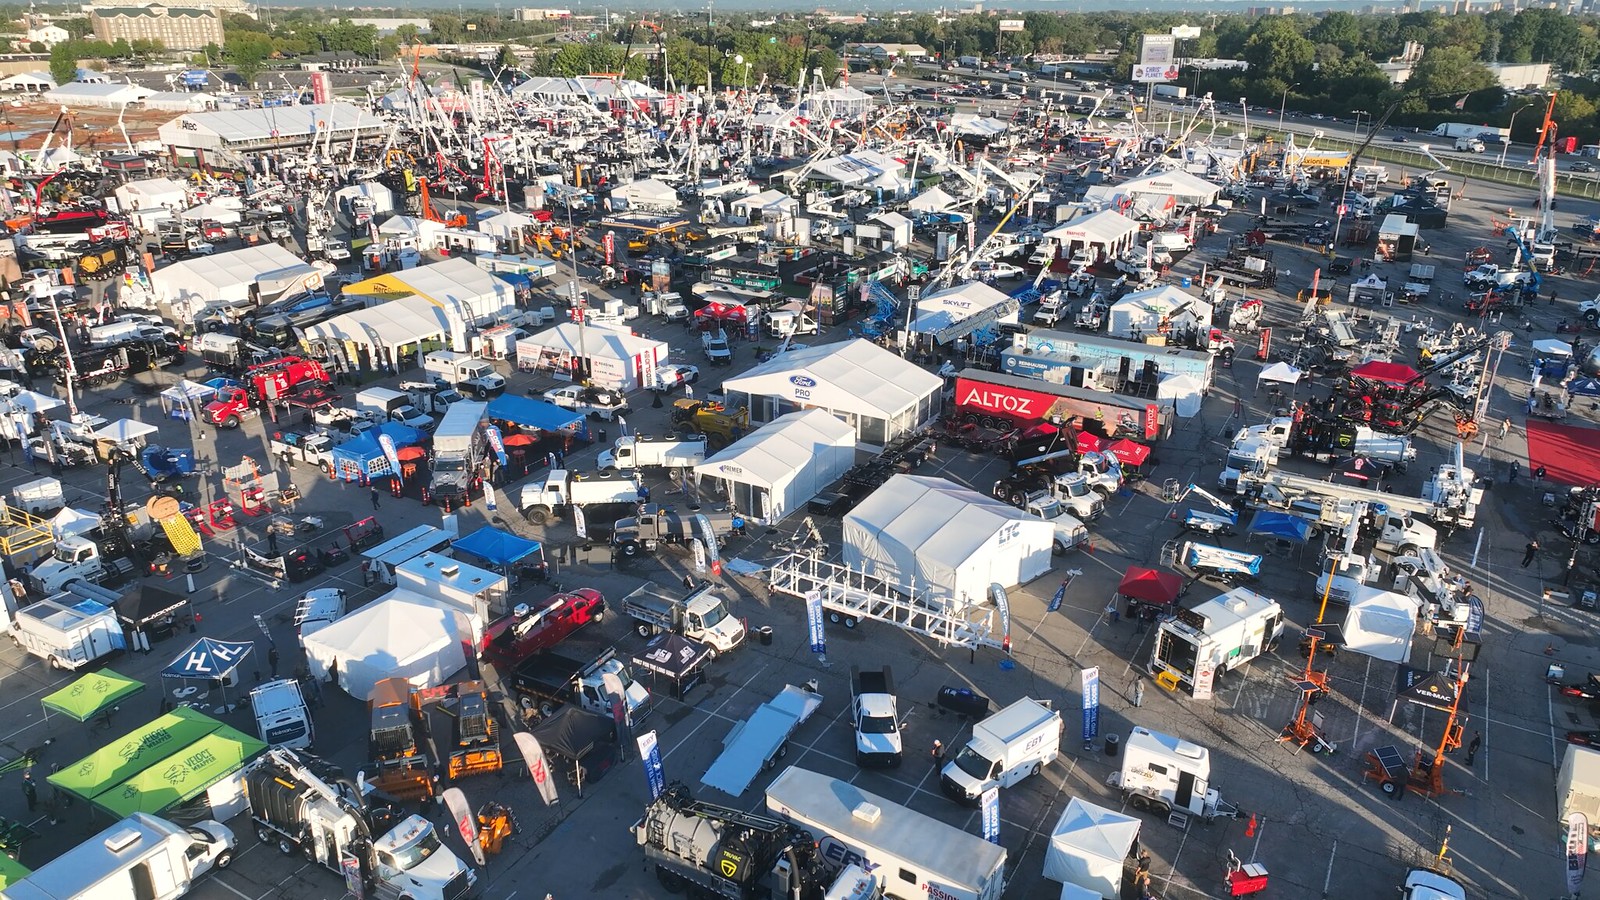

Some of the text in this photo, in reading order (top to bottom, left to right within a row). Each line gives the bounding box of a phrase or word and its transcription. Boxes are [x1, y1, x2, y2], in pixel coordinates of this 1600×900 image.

[182, 120, 198, 131] Altec
[942, 299, 973, 310] SKYLIFT
[1018, 361, 1048, 370] REINHAUSEN
[795, 388, 811, 397] PRO
[961, 388, 1033, 415] ALTOZ
[1147, 408, 1155, 430] ALTOZ
[723, 464, 743, 473] PREMIER
[999, 522, 1020, 544] LTC
[141, 600, 187, 622] BLACKWOOD
[1416, 688, 1451, 701] VER-MAC
[272, 727, 292, 737] Holman
[1026, 733, 1045, 751] EBY
[184, 749, 212, 767] VELOCI
[190, 756, 217, 771] WRAPPER
[723, 851, 742, 863] TRUVAC
